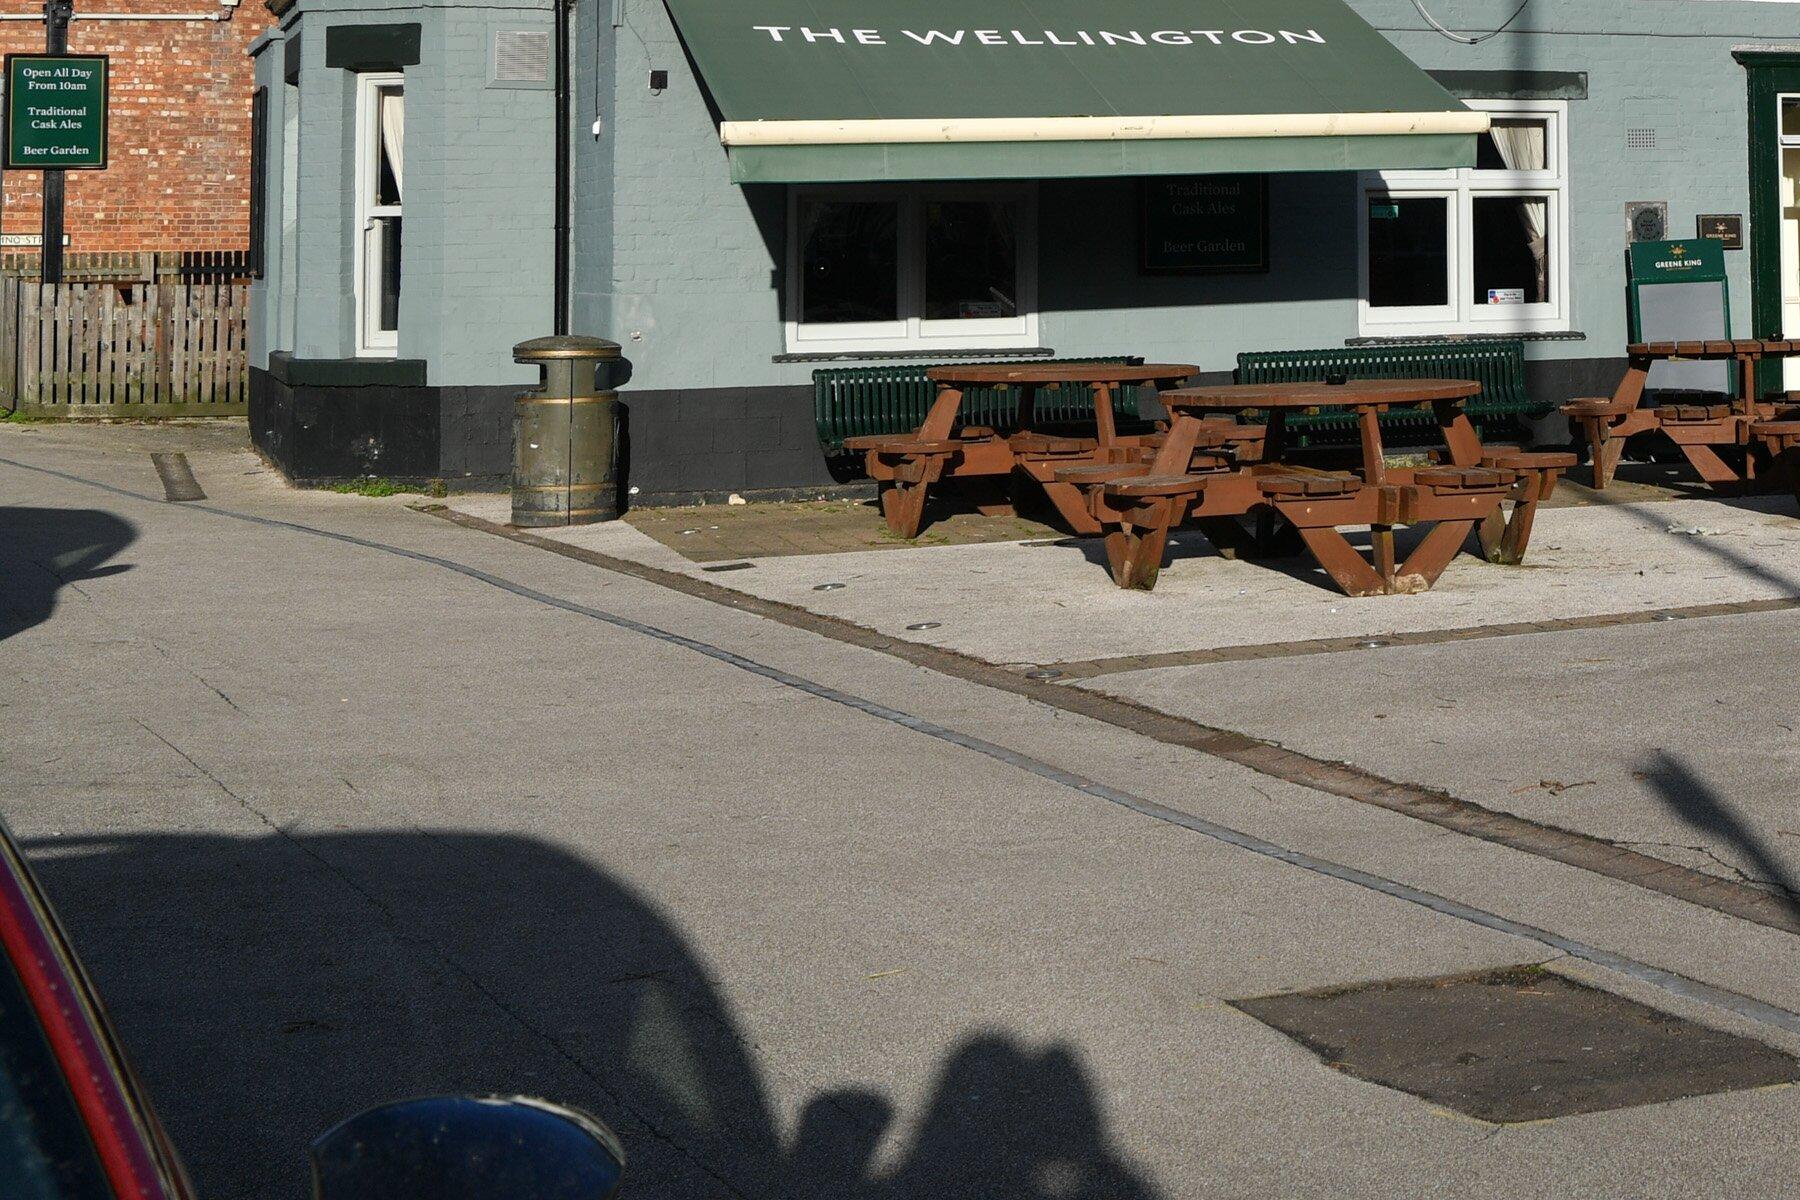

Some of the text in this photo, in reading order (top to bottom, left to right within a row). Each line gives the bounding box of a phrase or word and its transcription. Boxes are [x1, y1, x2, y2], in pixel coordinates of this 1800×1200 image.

[753, 25, 1326, 46] THE WELLINGTON
[23, 68, 92, 79] Open All Day
[28, 81, 87, 90] From 10am
[27, 106, 87, 116] Traditional
[31, 119, 82, 129] Cask Ales
[23, 145, 89, 155] Beer Garden
[1166, 182, 1240, 196] Traditional
[1172, 201, 1236, 215] Cask Ales
[1163, 240, 1246, 253] Beer Garden
[1655, 261, 1682, 269] GREENE
[1684, 259, 1702, 267] KING
